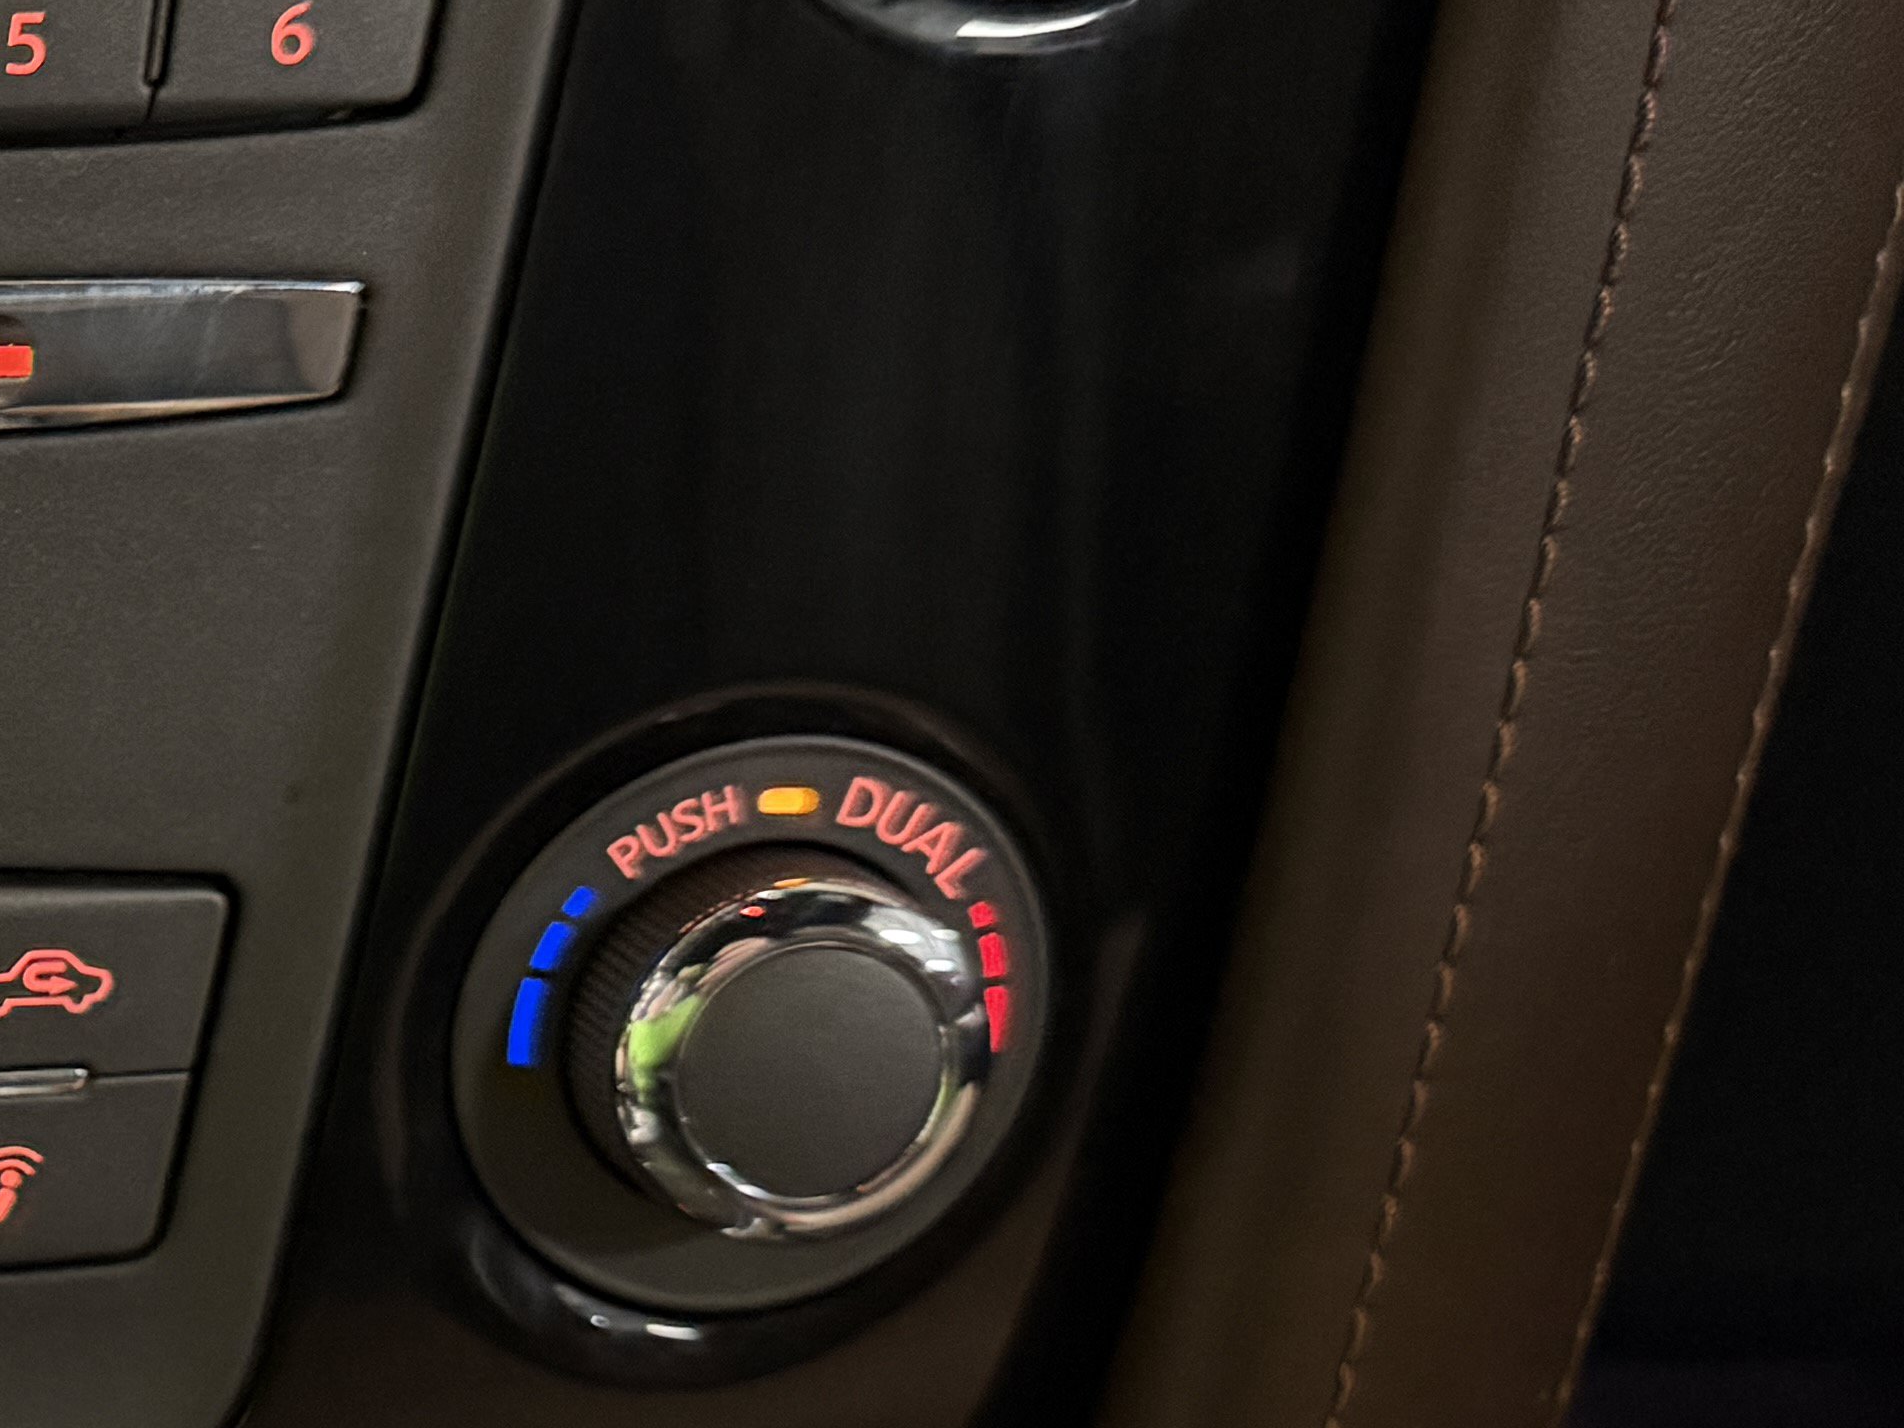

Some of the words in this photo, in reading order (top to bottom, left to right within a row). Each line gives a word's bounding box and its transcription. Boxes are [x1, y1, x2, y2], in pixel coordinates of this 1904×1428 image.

[4, 10, 49, 77] 5
[269, 1, 315, 67] 6
[606, 784, 744, 881] PUSH
[835, 775, 989, 901] DUAL
